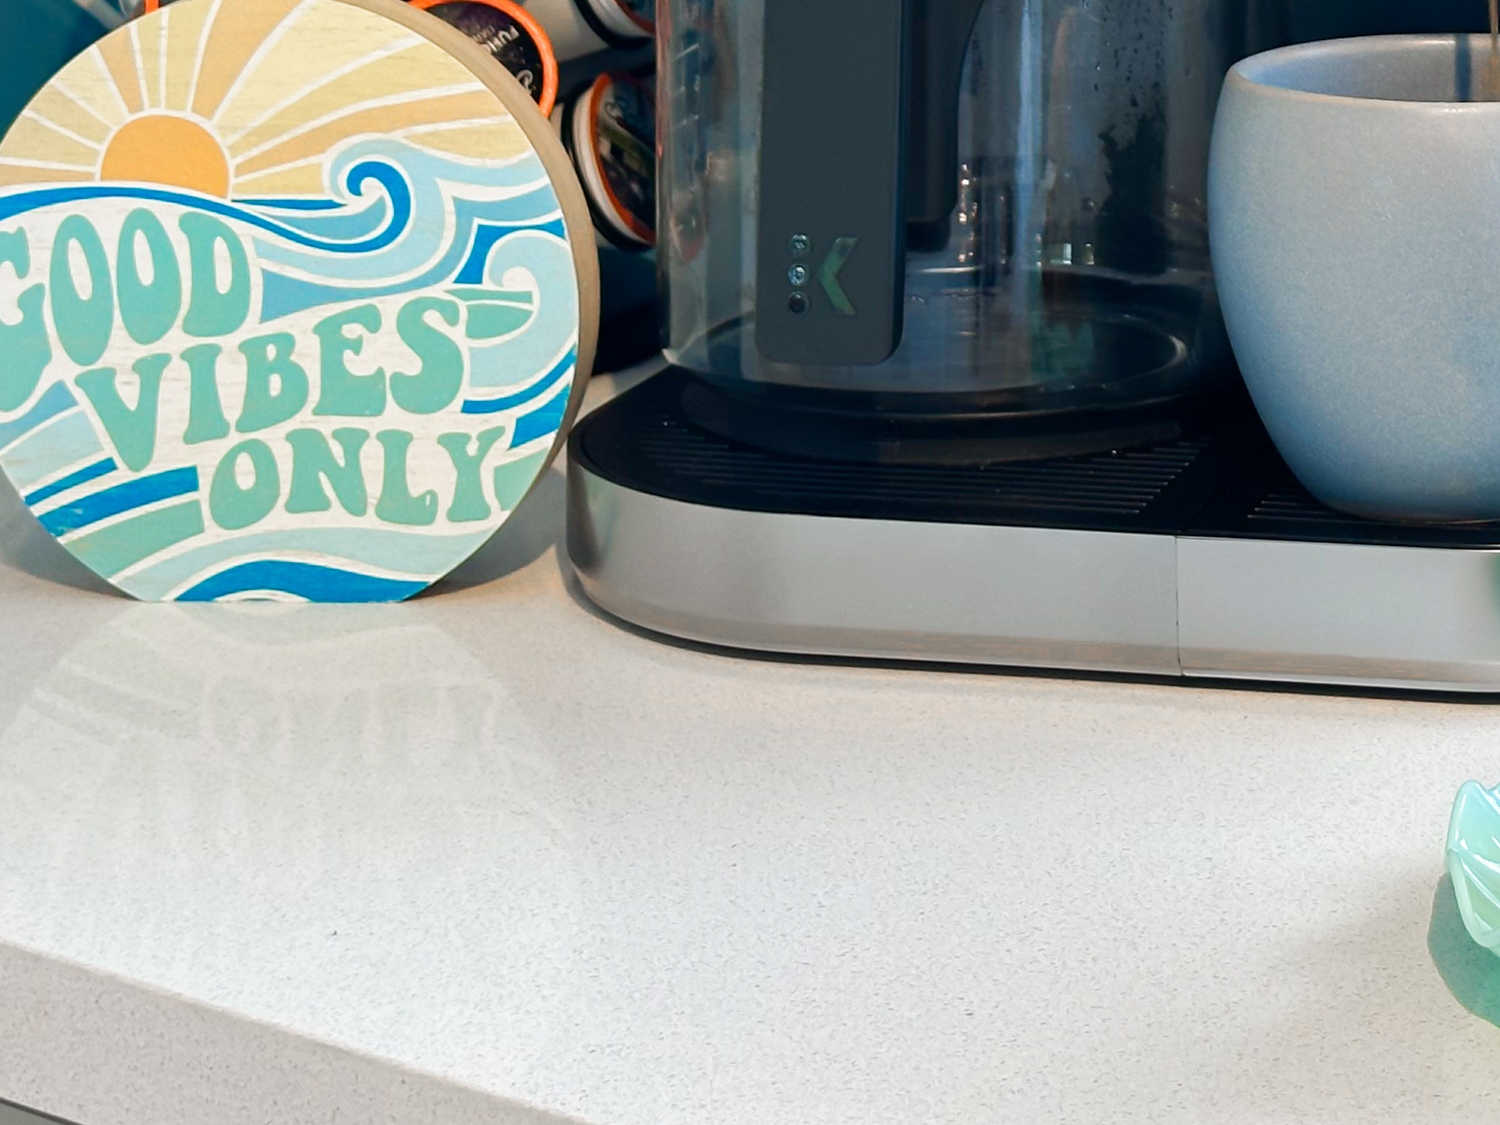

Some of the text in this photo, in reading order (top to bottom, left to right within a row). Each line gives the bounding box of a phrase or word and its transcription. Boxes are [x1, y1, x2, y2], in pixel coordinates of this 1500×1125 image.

[0, 207, 252, 413] GOOD
[75, 295, 465, 473] VIBES
[208, 424, 508, 532] ONLY
